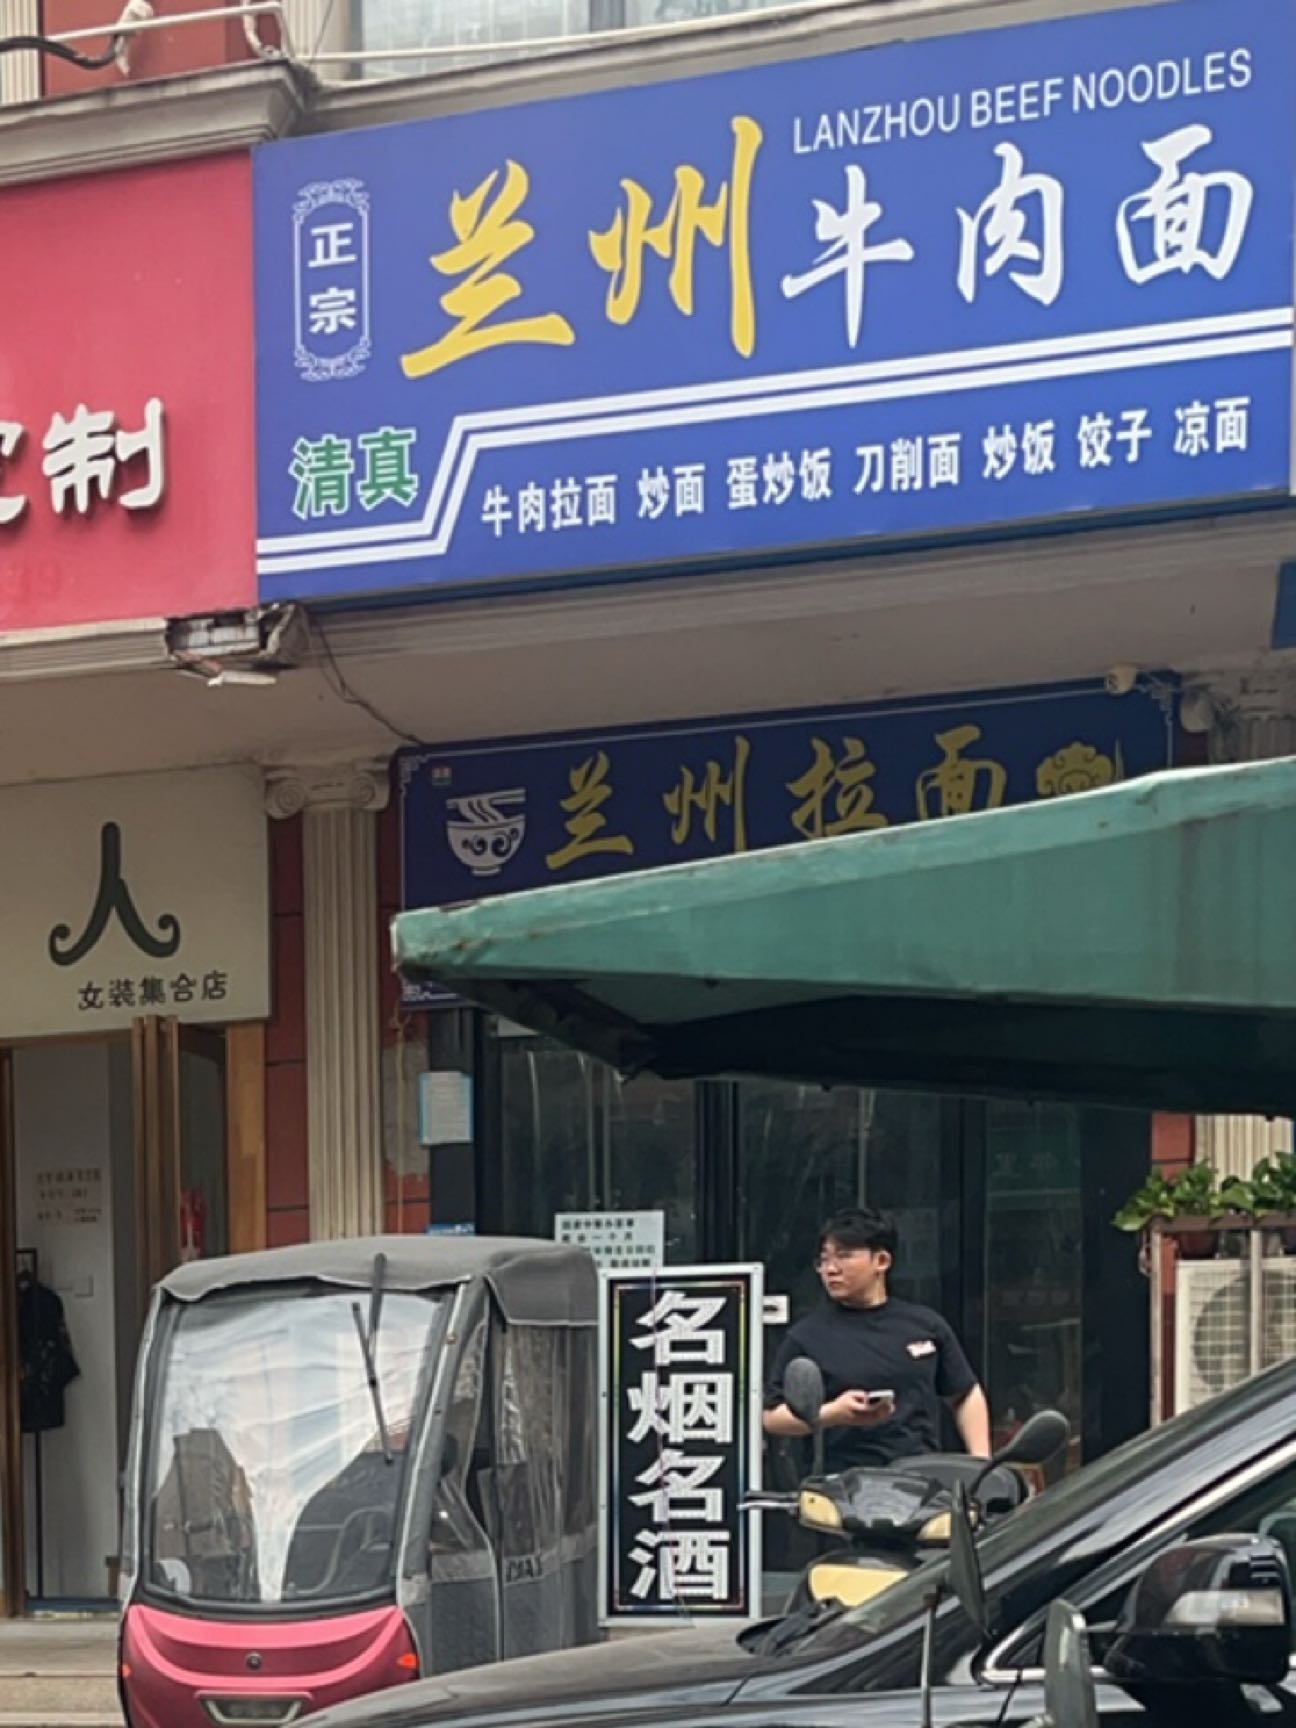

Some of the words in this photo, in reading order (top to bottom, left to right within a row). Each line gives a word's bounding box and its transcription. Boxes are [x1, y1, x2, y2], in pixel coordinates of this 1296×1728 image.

[793, 94, 961, 155] LANZHOU
[971, 80, 1063, 130] BEEF
[1073, 48, 1253, 115] NOODLES
[308, 222, 357, 335] 正宗
[400, 117, 1254, 377] 兰州牛肉面
[291, 427, 418, 519] 清真
[481, 475, 618, 538] 牛肉拉面
[638, 465, 705, 519] 炒面
[726, 450, 832, 509] 蛋炒饭
[854, 433, 962, 495] 刀削面
[983, 416, 1056, 478] 炒饭
[1078, 407, 1153, 467] 饺子
[1174, 396, 1250, 454] 凉面
[545, 725, 1005, 869] 兰州拉面
[78, 970, 230, 1011] 女装集合店
[626, 1289, 732, 1601] 名烟名酒
